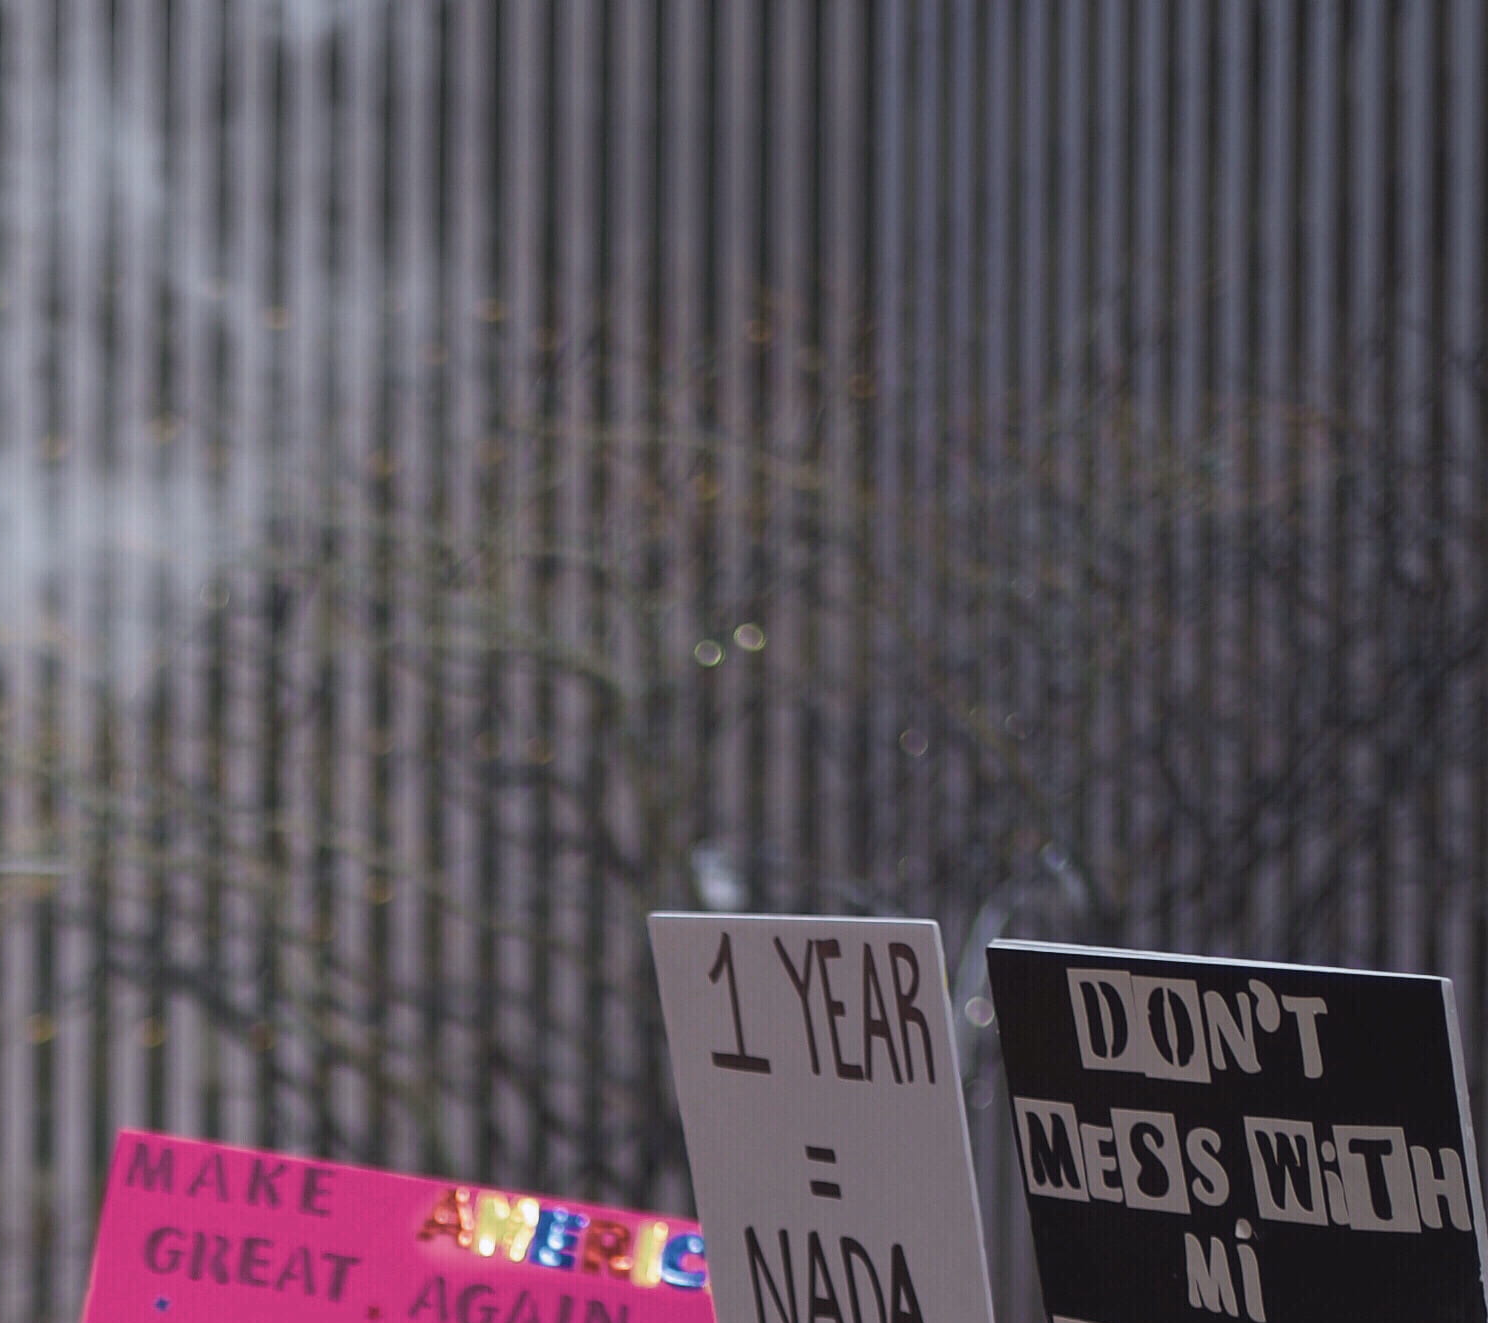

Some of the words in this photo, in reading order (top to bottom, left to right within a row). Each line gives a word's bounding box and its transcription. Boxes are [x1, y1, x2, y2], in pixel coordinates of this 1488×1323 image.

[708, 932, 772, 1074] 1
[773, 935, 936, 1085] YEAR
[1074, 976, 1328, 1079] DON'T
[1022, 1109, 1231, 1207] MESS
[125, 1142, 337, 1218] MAKE
[417, 1186, 709, 1291] AMERIC
[145, 1226, 361, 1303] GREAT
